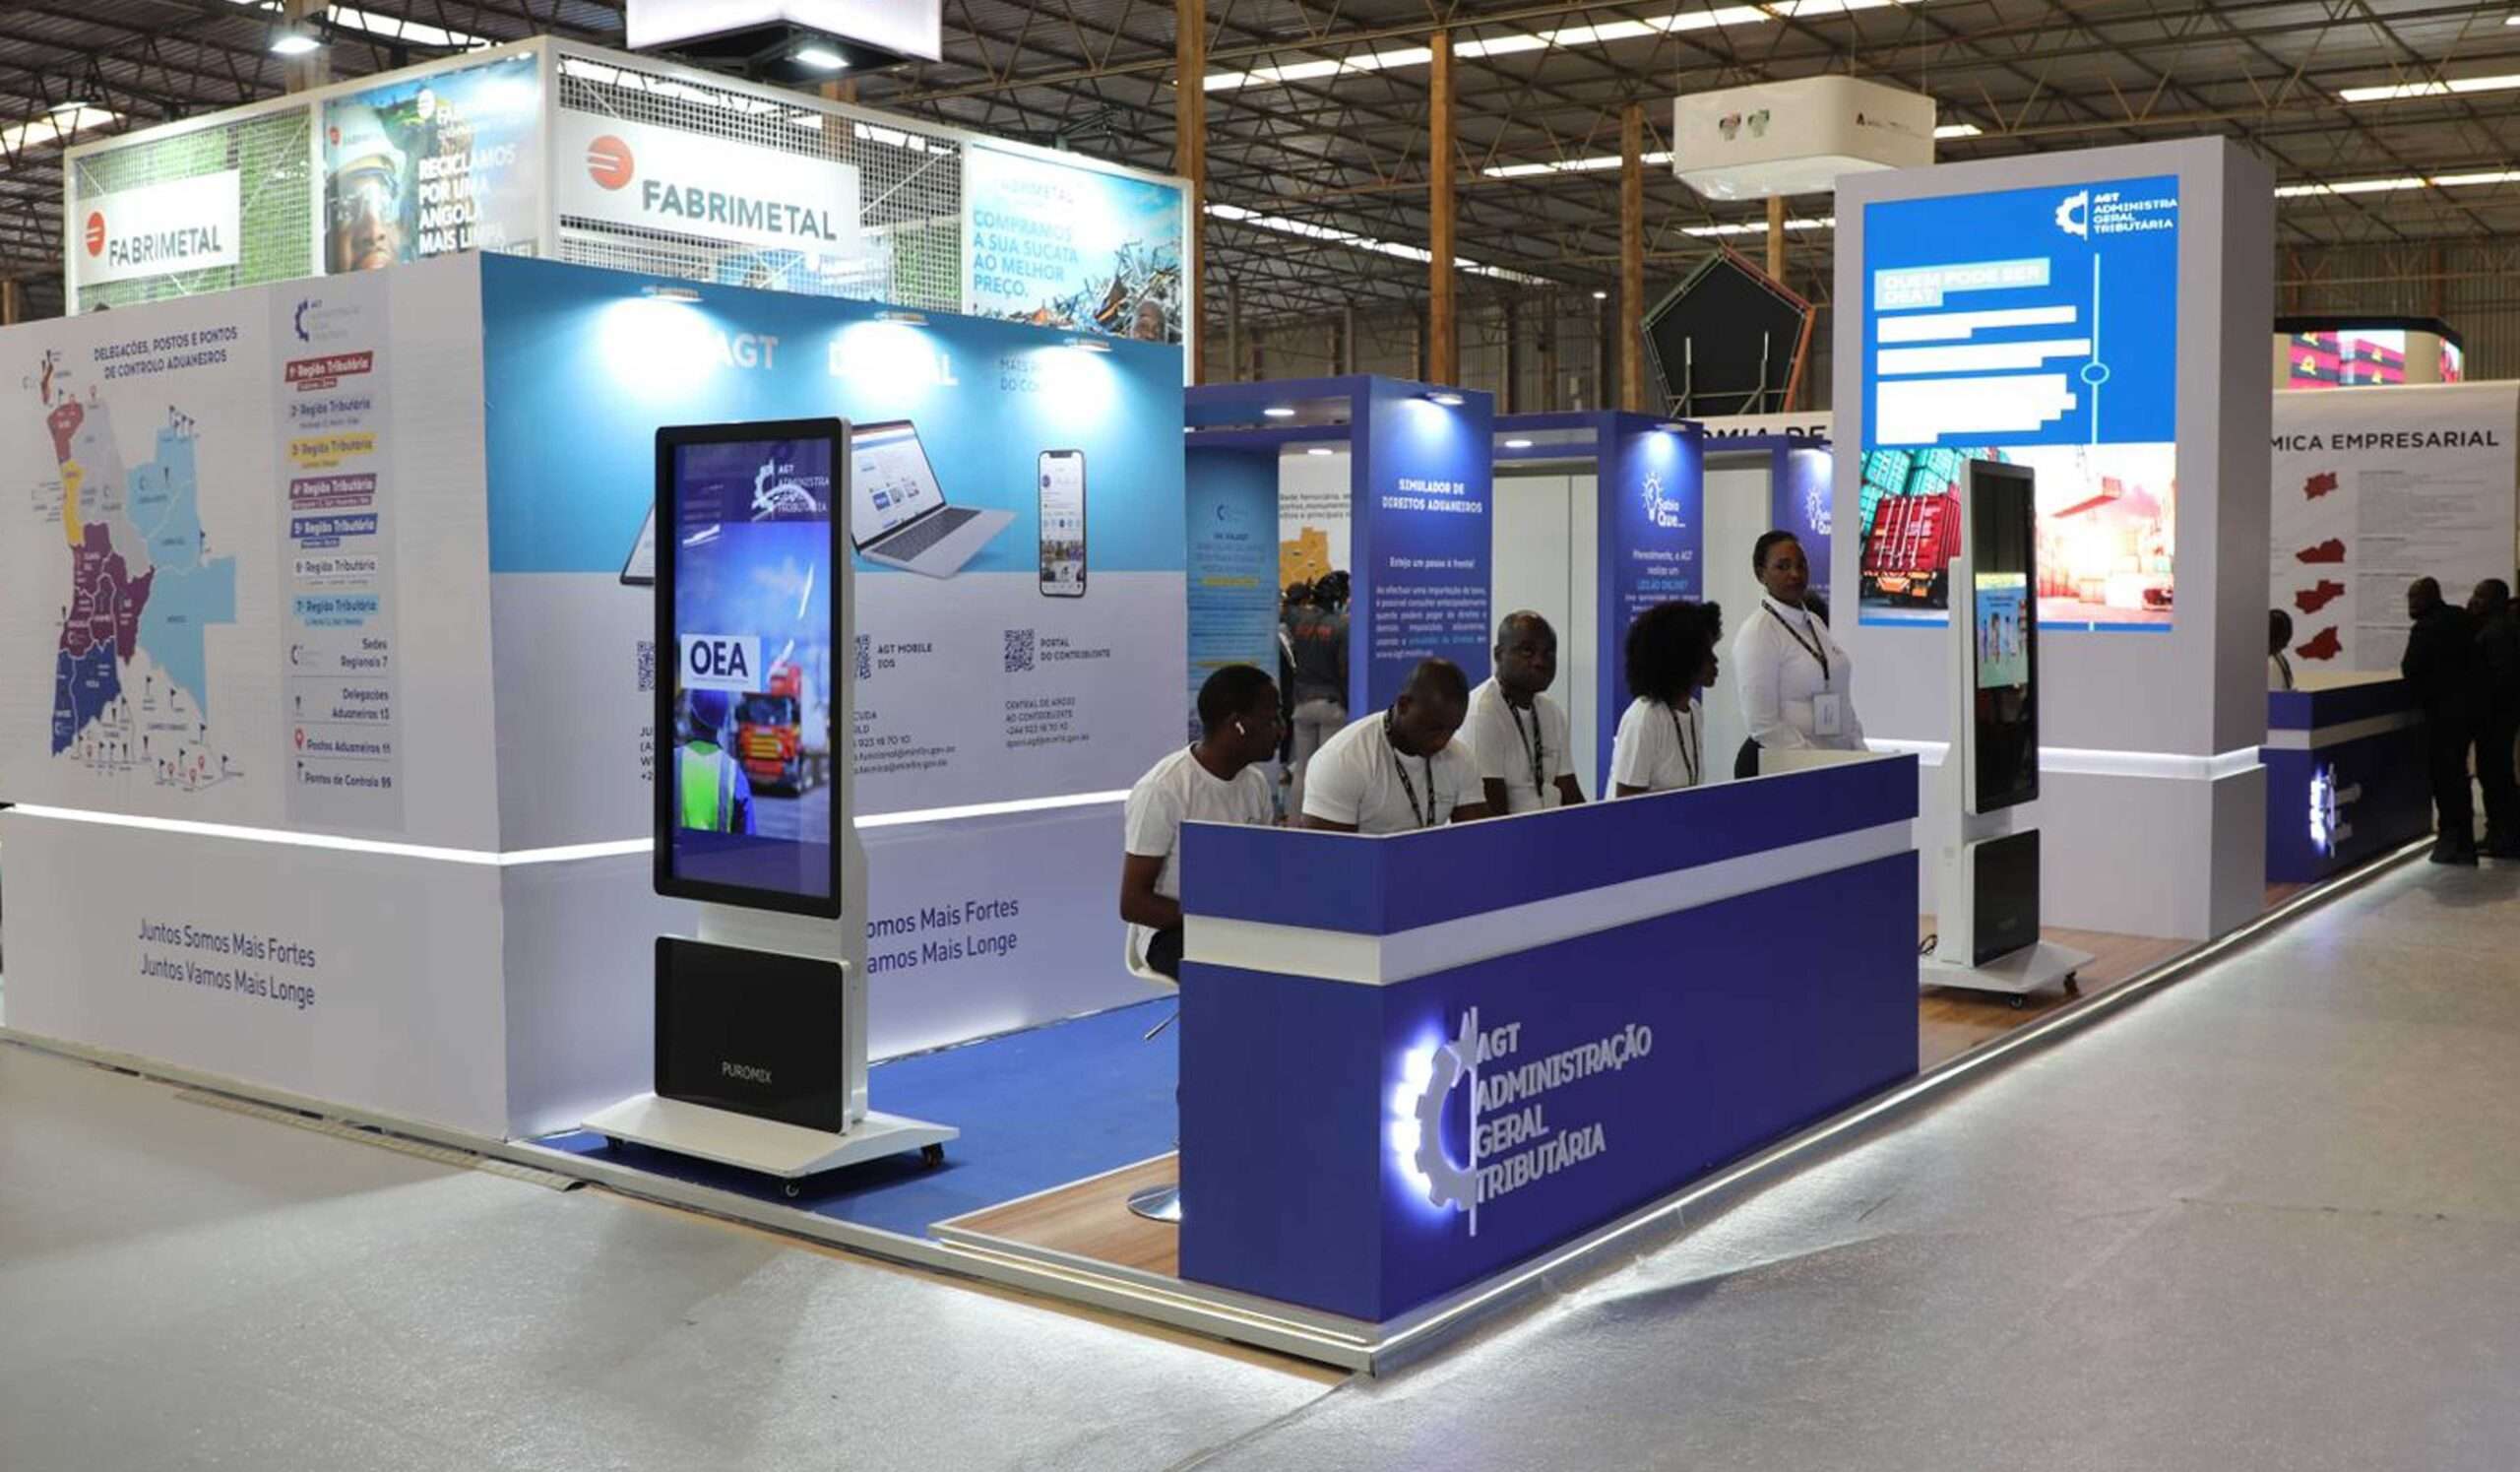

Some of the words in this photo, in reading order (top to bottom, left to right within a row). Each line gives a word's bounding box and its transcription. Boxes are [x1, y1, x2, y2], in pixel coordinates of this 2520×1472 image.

[418, 143, 516, 180] RECICLAMOS
[418, 179, 451, 206] POR
[2094, 192, 2120, 204] AGT
[418, 199, 483, 230] ANGOLA
[642, 178, 837, 241] FABRIMETAL
[2093, 213, 2135, 224] GERAL
[2094, 199, 2178, 215] ADMINISTRA
[973, 210, 1072, 243] COMPRAMOS
[2094, 219, 2174, 234] TRIBUTÁRIA
[108, 224, 222, 268] FABRIMETAL
[418, 229, 457, 255] MAIS
[973, 231, 984, 248] A
[987, 232, 1019, 253] SUA
[1023, 239, 1079, 264] SUCATA
[973, 253, 998, 272] AO
[1001, 255, 1065, 283] MELHOR
[973, 273, 1029, 299] PREÇO.
[94, 341, 151, 361] DELEGAÇÕES,
[153, 332, 190, 352] POSTOS
[192, 331, 197, 346] E
[200, 326, 238, 345] PONTOS
[104, 365, 116, 380] DE
[118, 358, 165, 378] CONTROLO
[167, 349, 227, 371] ADUANEIROS
[2331, 430, 2499, 451] EMPRESARIAL
[1399, 479, 1451, 493] SIMULADOR
[1453, 482, 1465, 495] DE
[1382, 495, 1425, 511] DIREITOS
[1427, 499, 1483, 513] ADUANEIROS
[362, 637, 388, 651] Sedes
[878, 644, 895, 654] AGT
[898, 643, 932, 654] MOBILE
[1040, 638, 1069, 648] PORTAL
[383, 655, 388, 668] 7
[690, 640, 749, 677] OEA
[877, 659, 895, 670] IOS
[1040, 651, 1052, 662] DO
[641, 727, 654, 737] JU
[641, 740, 654, 752] (A
[641, 770, 654, 782] +2
[866, 915, 916, 938] omos
[919, 904, 962, 931] Mais
[965, 897, 1020, 925] Fortes
[139, 918, 182, 946] Juntos
[184, 925, 230, 954] Somos
[232, 931, 266, 960] Mais
[268, 938, 316, 969] Fortes
[866, 951, 918, 975] amos
[921, 940, 964, 965] Mais
[967, 930, 1019, 958] Longe
[141, 952, 184, 982] Juntos
[186, 961, 231, 992] Vamos
[234, 968, 268, 997] Mais
[270, 976, 316, 1010] Longe
[1477, 1022, 1522, 1065] AGT
[722, 1060, 773, 1084] PUROMIX
[1477, 1023, 1654, 1116] ADMINISTRAÇÃO
[1477, 1104, 1550, 1159] GERAL
[1477, 1121, 1606, 1204] TRIBUTÁRIA
